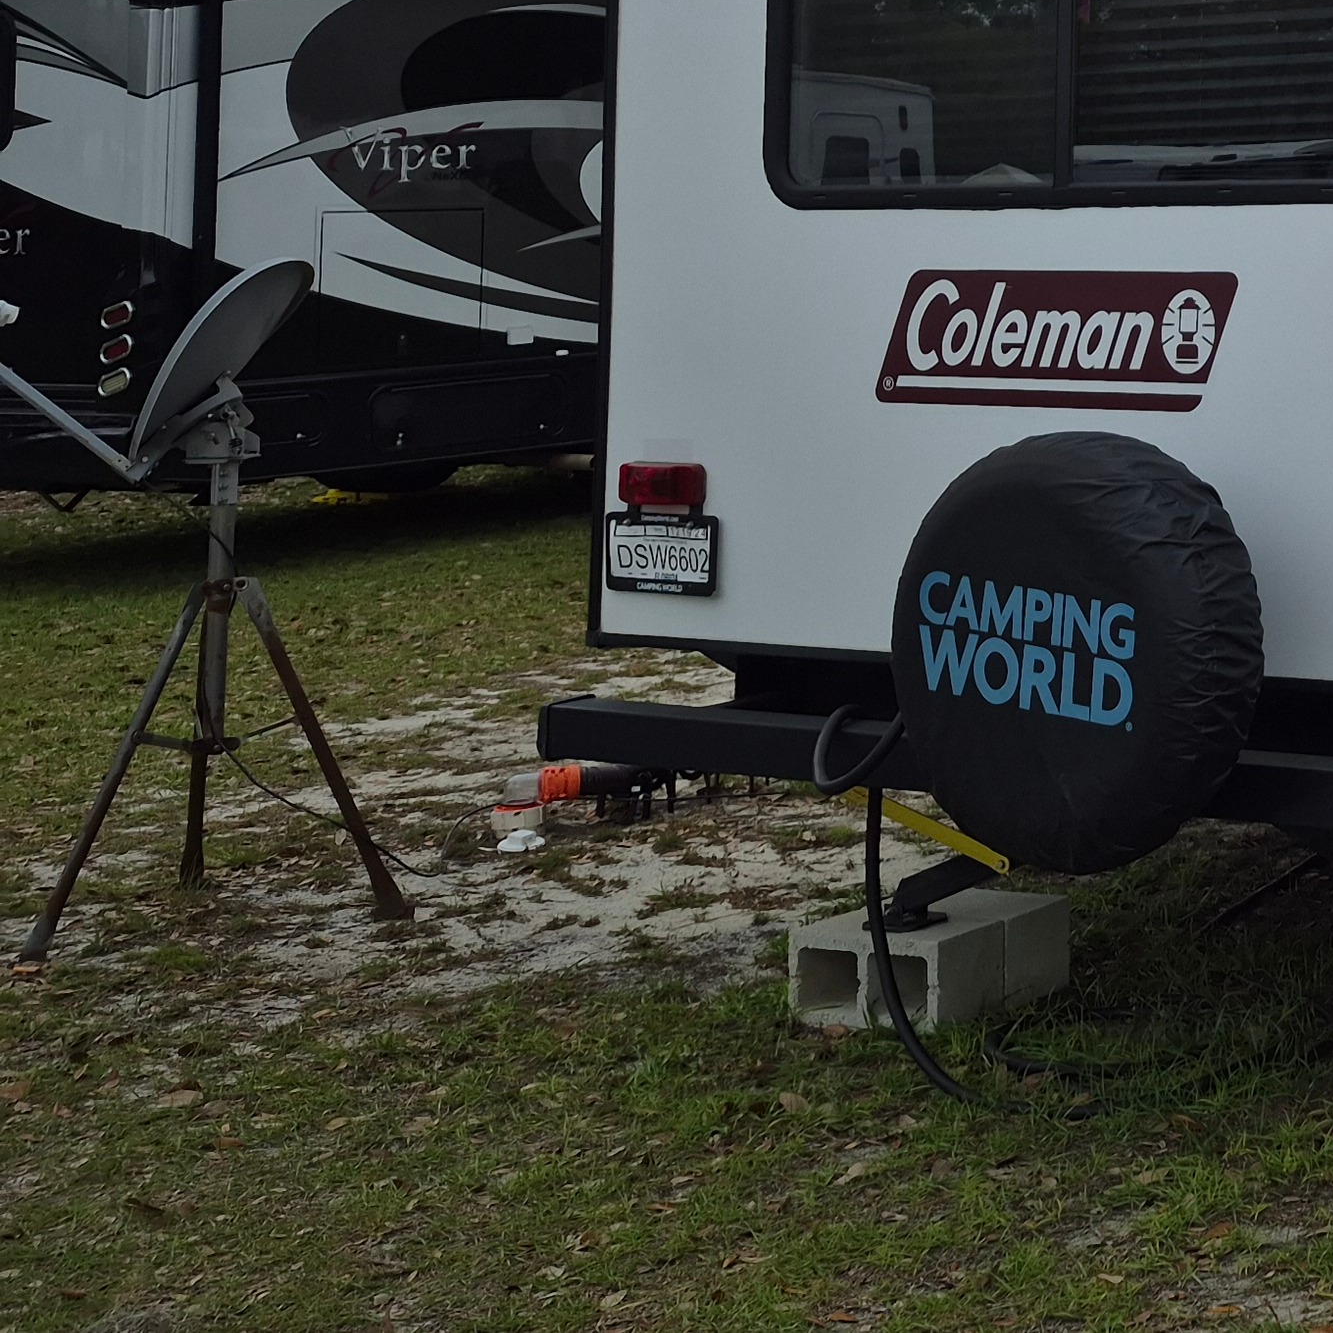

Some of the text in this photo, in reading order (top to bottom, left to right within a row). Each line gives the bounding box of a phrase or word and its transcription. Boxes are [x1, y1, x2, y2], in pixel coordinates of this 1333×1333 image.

[339, 125, 477, 183] Viper
[905, 278, 1155, 371] Coleman
[617, 544, 710, 573] DSW6602
[919, 570, 1136, 660] CAMPING
[918, 624, 1134, 727] WORLD
